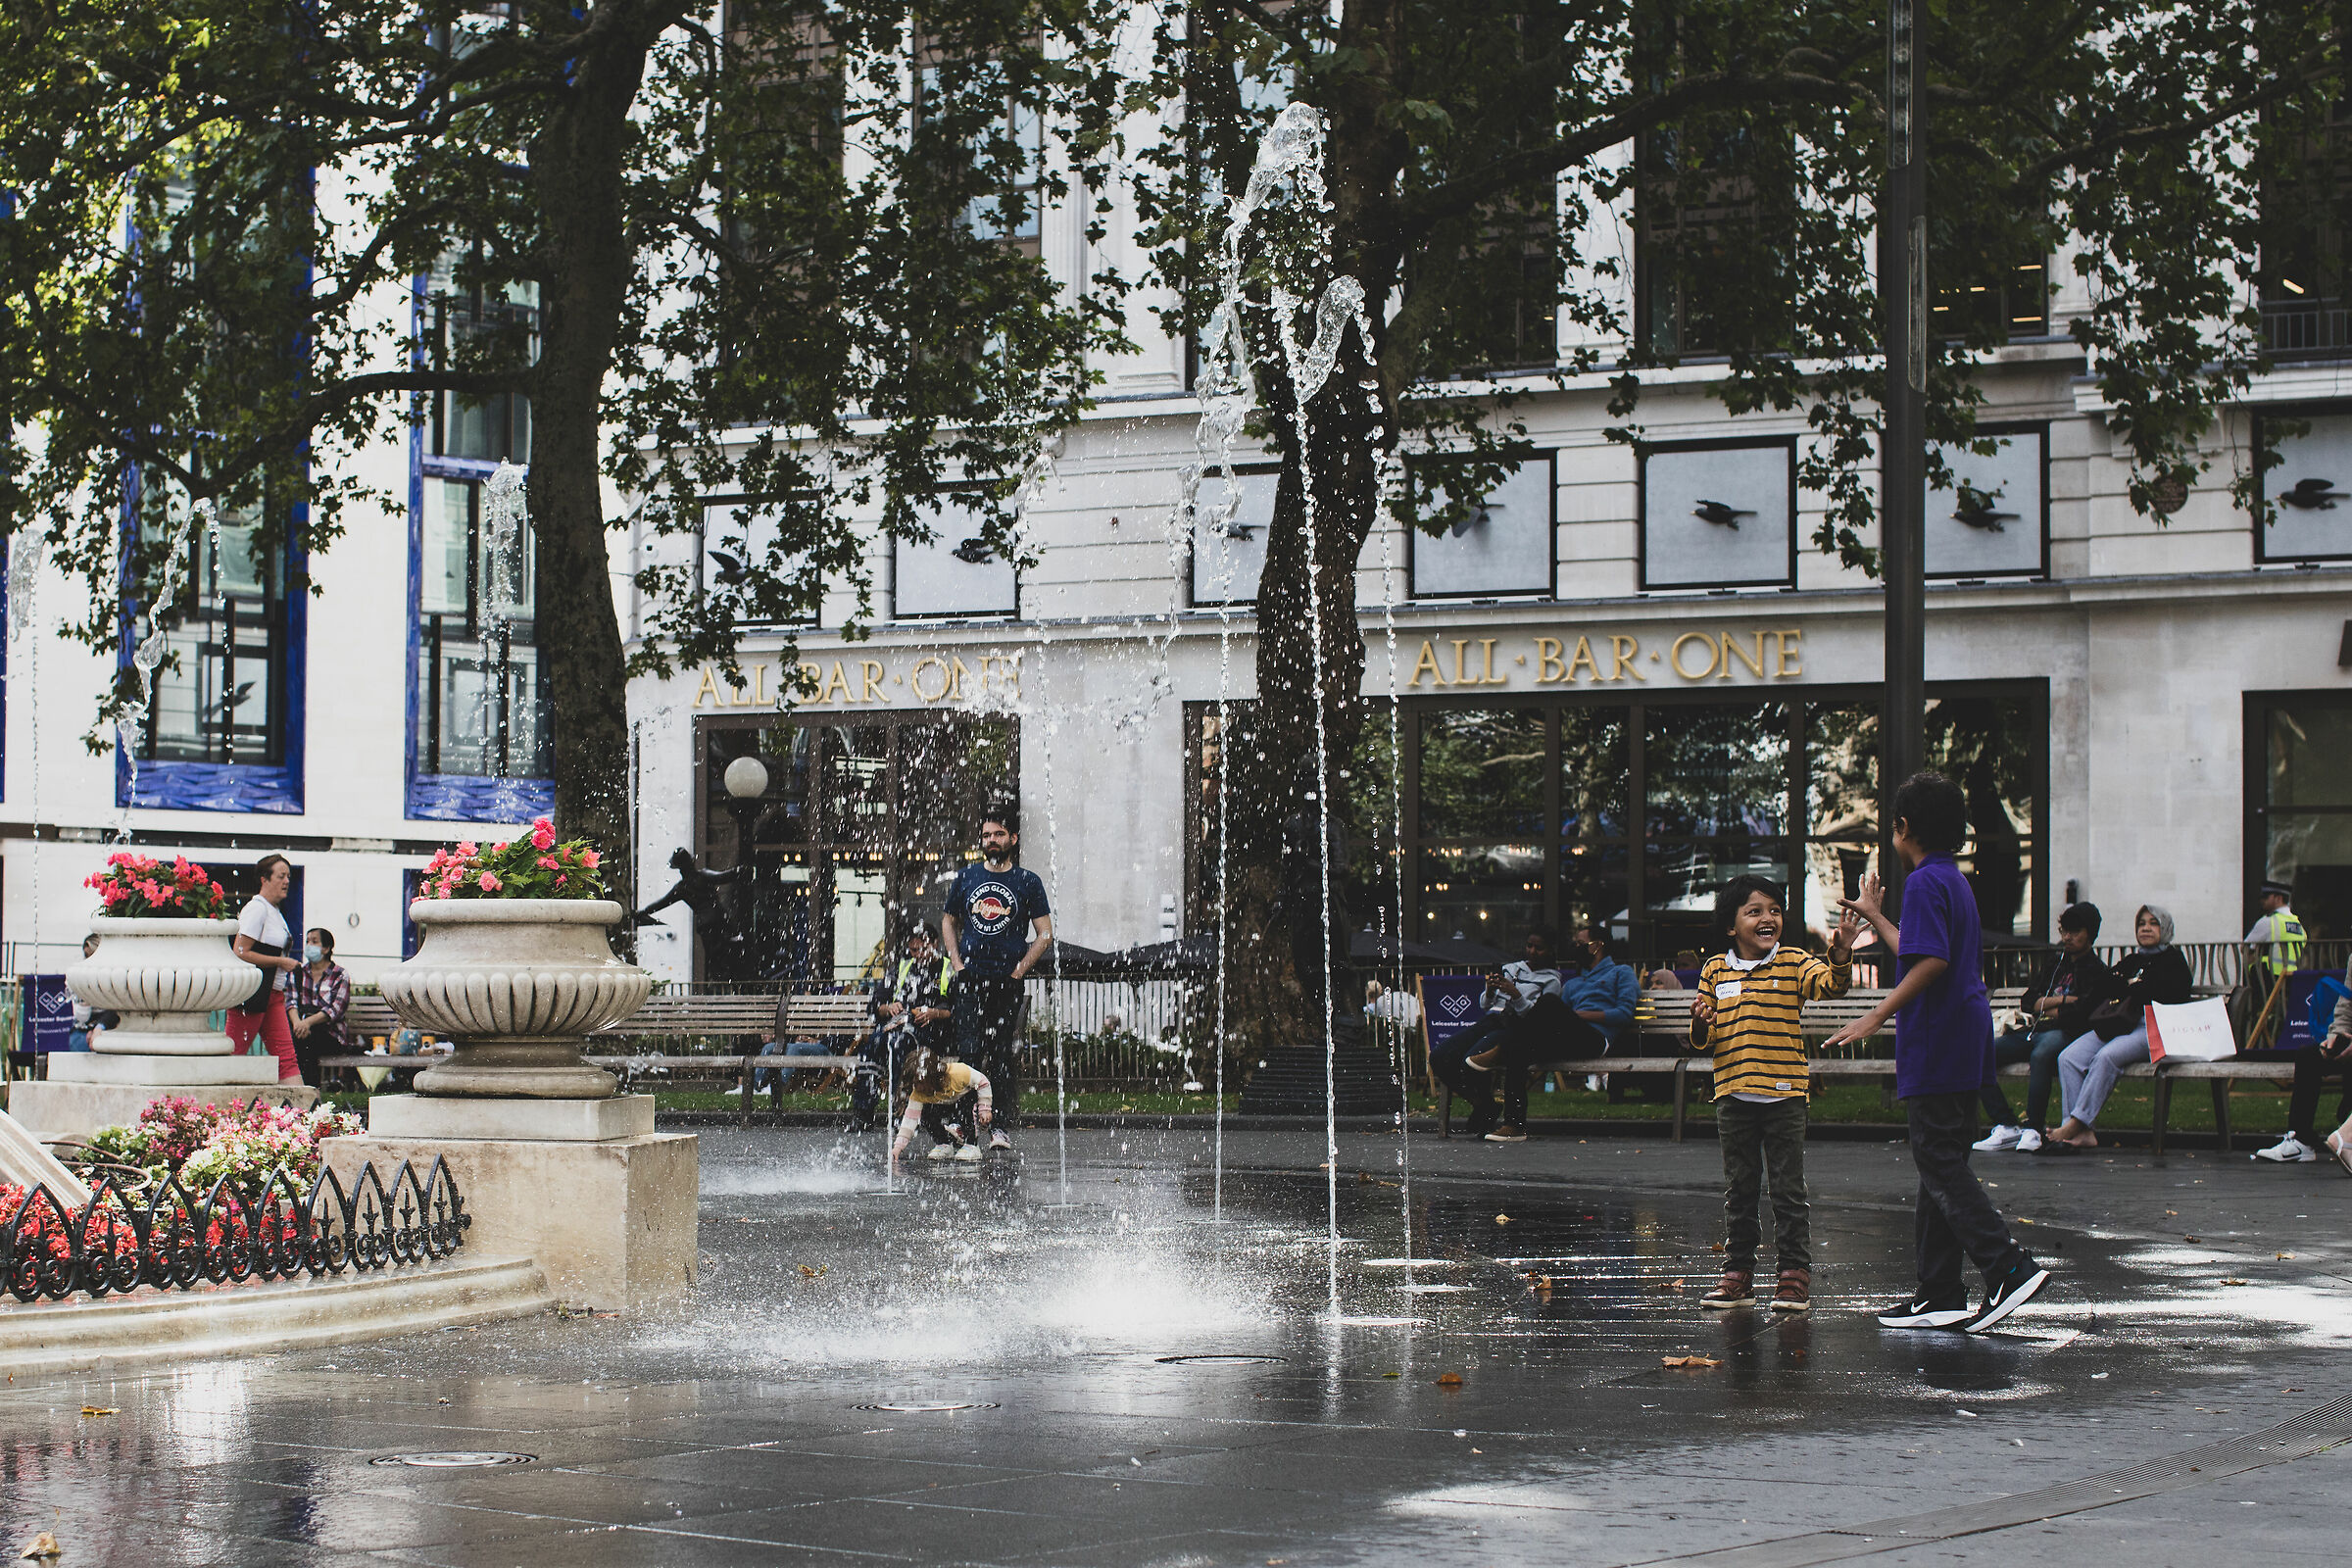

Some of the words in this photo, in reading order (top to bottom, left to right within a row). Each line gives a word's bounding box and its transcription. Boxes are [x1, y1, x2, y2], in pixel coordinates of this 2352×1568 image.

[1405, 638, 1508, 686] ALL
[1532, 634, 1647, 684] BAR
[1670, 628, 1803, 680] ONE
[796, 660, 891, 705] BAR
[969, 885, 990, 904] BLEND
[991, 884, 1015, 906] GLOBAL
